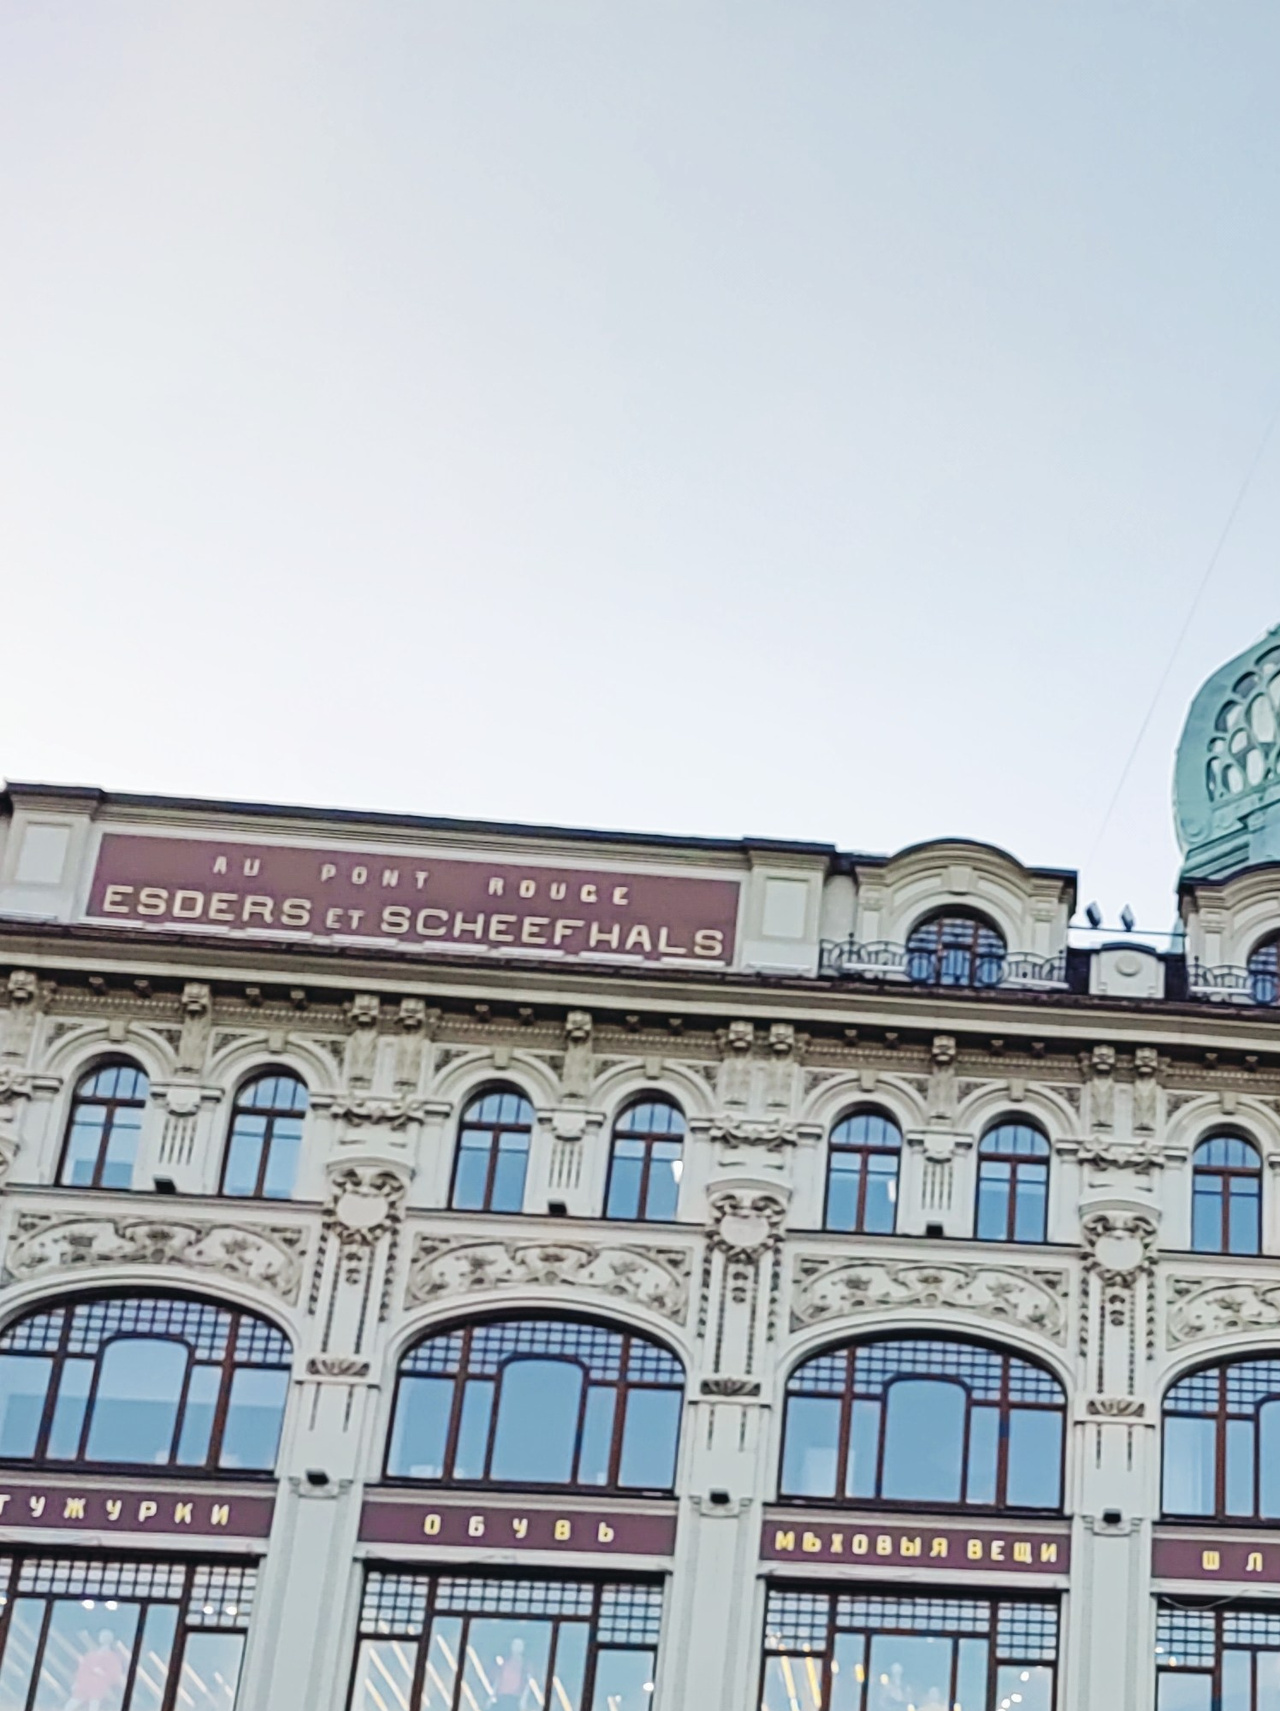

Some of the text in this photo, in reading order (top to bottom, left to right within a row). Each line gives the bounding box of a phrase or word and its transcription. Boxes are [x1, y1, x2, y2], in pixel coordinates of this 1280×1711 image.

[211, 855, 630, 906] AU PONT ROUGE
[102, 885, 725, 957] ESDERS ET SCHEEFHALS
[423, 1513, 615, 1543] ОБУВЬ
[966, 1538, 1058, 1564] ВЕЩИ
